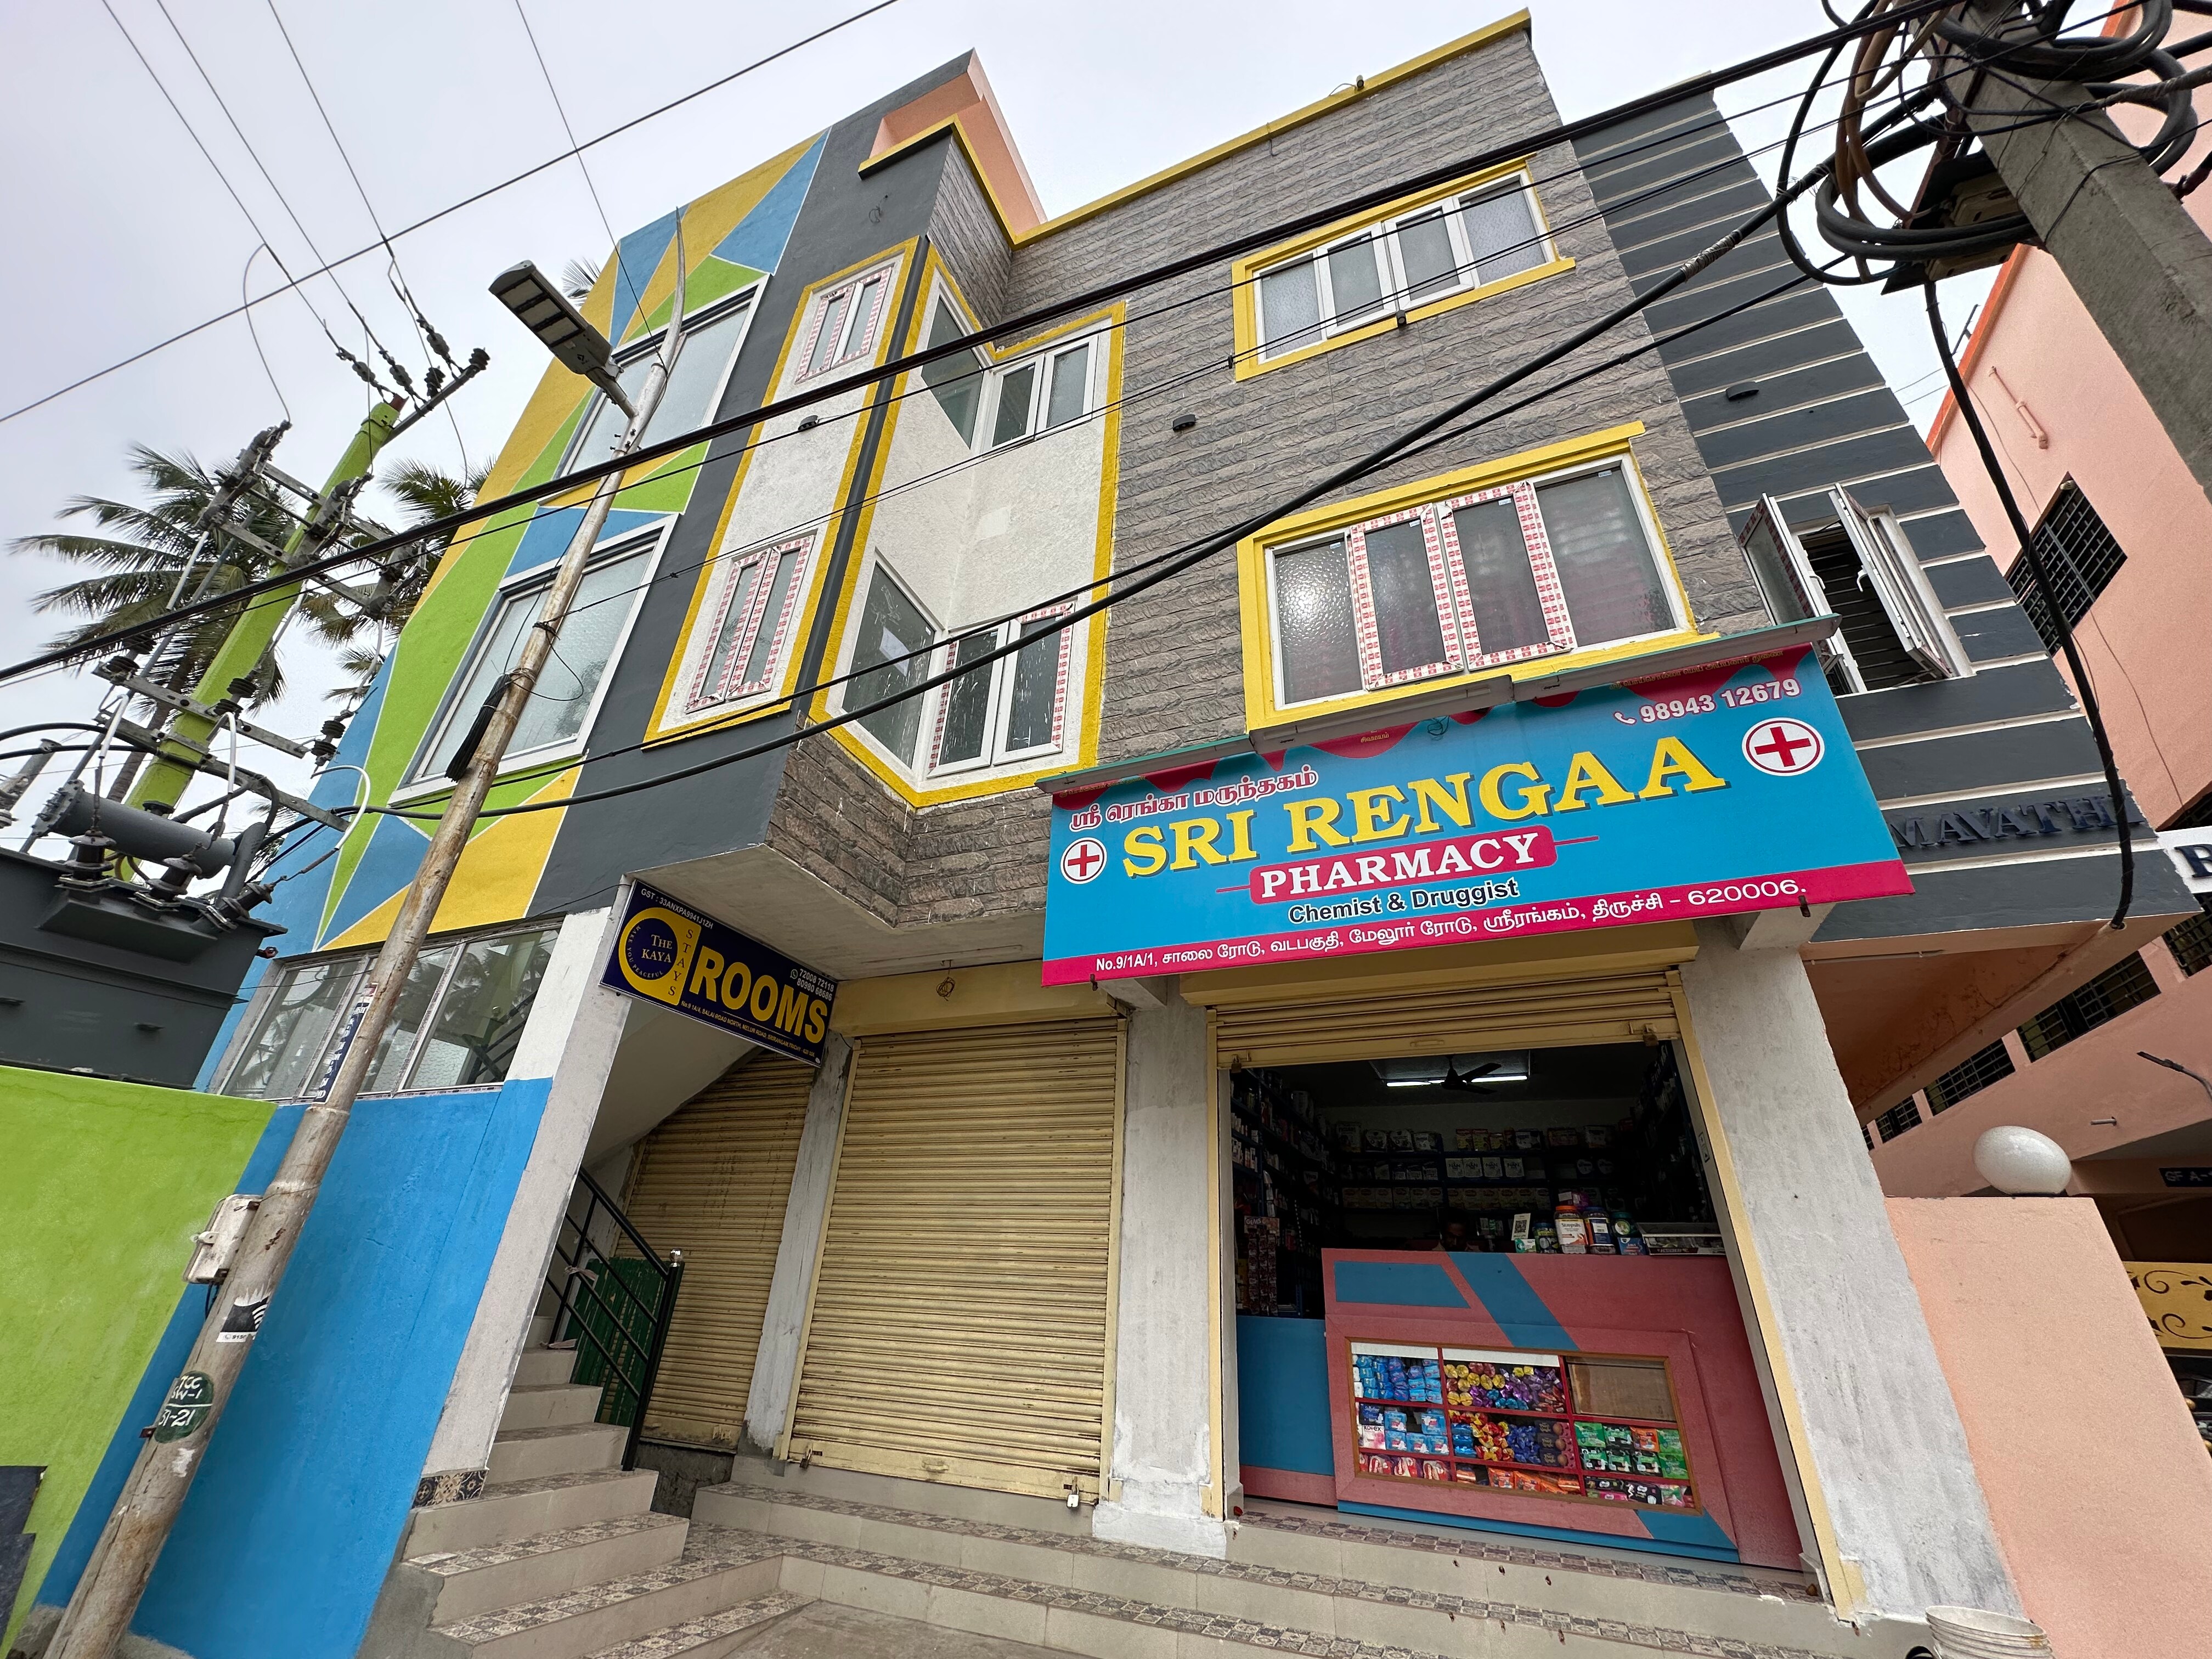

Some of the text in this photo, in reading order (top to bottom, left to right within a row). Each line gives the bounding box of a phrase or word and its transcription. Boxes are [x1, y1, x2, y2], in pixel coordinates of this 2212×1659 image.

[1640, 678, 1801, 723] 98943 12679
[1070, 764, 1318, 831] ஸ்ரீ ரெங்கா மருந்தகம்
[1123, 736, 1727, 878] SRI RENGAA
[1261, 832, 1539, 898] PHARMACY
[641, 888, 656, 900] GST
[1289, 878, 1520, 923] Chemist & Druggist
[628, 925, 641, 943] MAKE
[1096, 952, 1158, 971] No.9/1A/1,
[1162, 949, 1212, 964] சாலை
[1217, 940, 1265, 960] ரோடு,
[1271, 930, 1344, 952] வடபகுதி,
[1349, 922, 1415, 945] மேலூர்
[1420, 916, 1477, 937] ரோடு,
[1592, 892, 1664, 922] திருச்சி
[1688, 879, 1807, 905] 620006.
[633, 963, 664, 979] PEACEFUL
[641, 948, 672, 963] KAYA
[668, 929, 693, 996] STAYS
[689, 945, 827, 1043] ROOMS
[797, 978, 833, 1001] 80980 68686
[799, 968, 834, 992] 72008 72118
